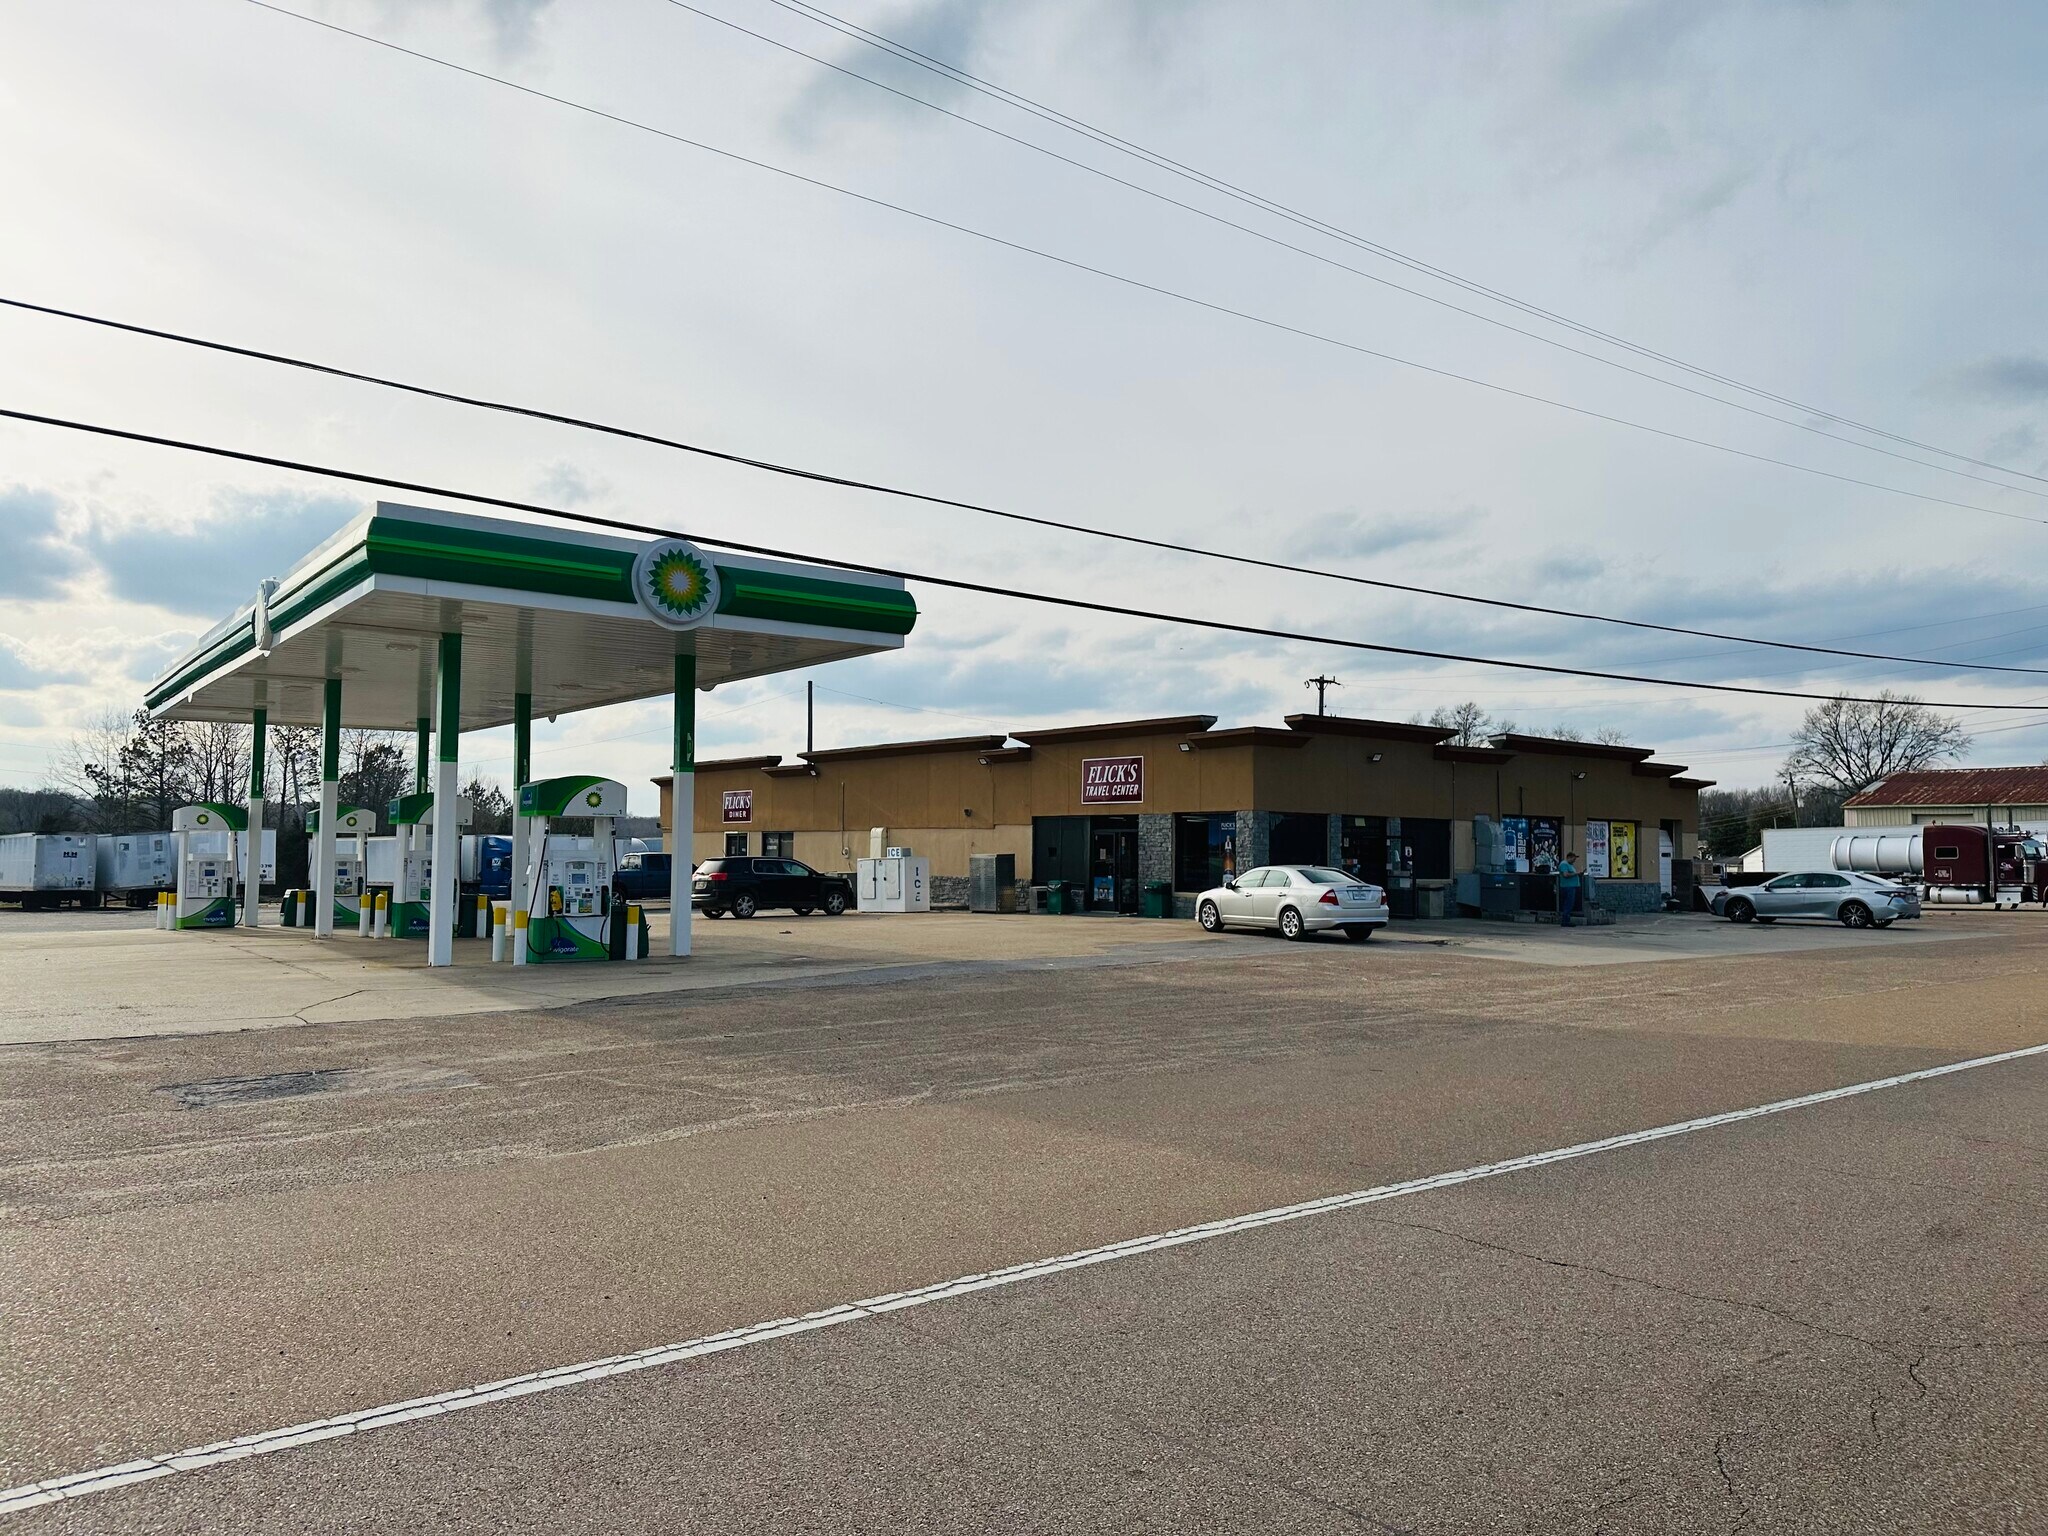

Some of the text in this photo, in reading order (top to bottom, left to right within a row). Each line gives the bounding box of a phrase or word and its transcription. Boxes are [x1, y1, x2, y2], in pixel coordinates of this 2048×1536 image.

[1087, 764, 1138, 784] FLICK'S
[1085, 784, 1139, 797] TRAVEL CENTER
[724, 795, 751, 809] FLICK'S
[729, 810, 747, 818] DINER
[888, 848, 900, 857] ICE
